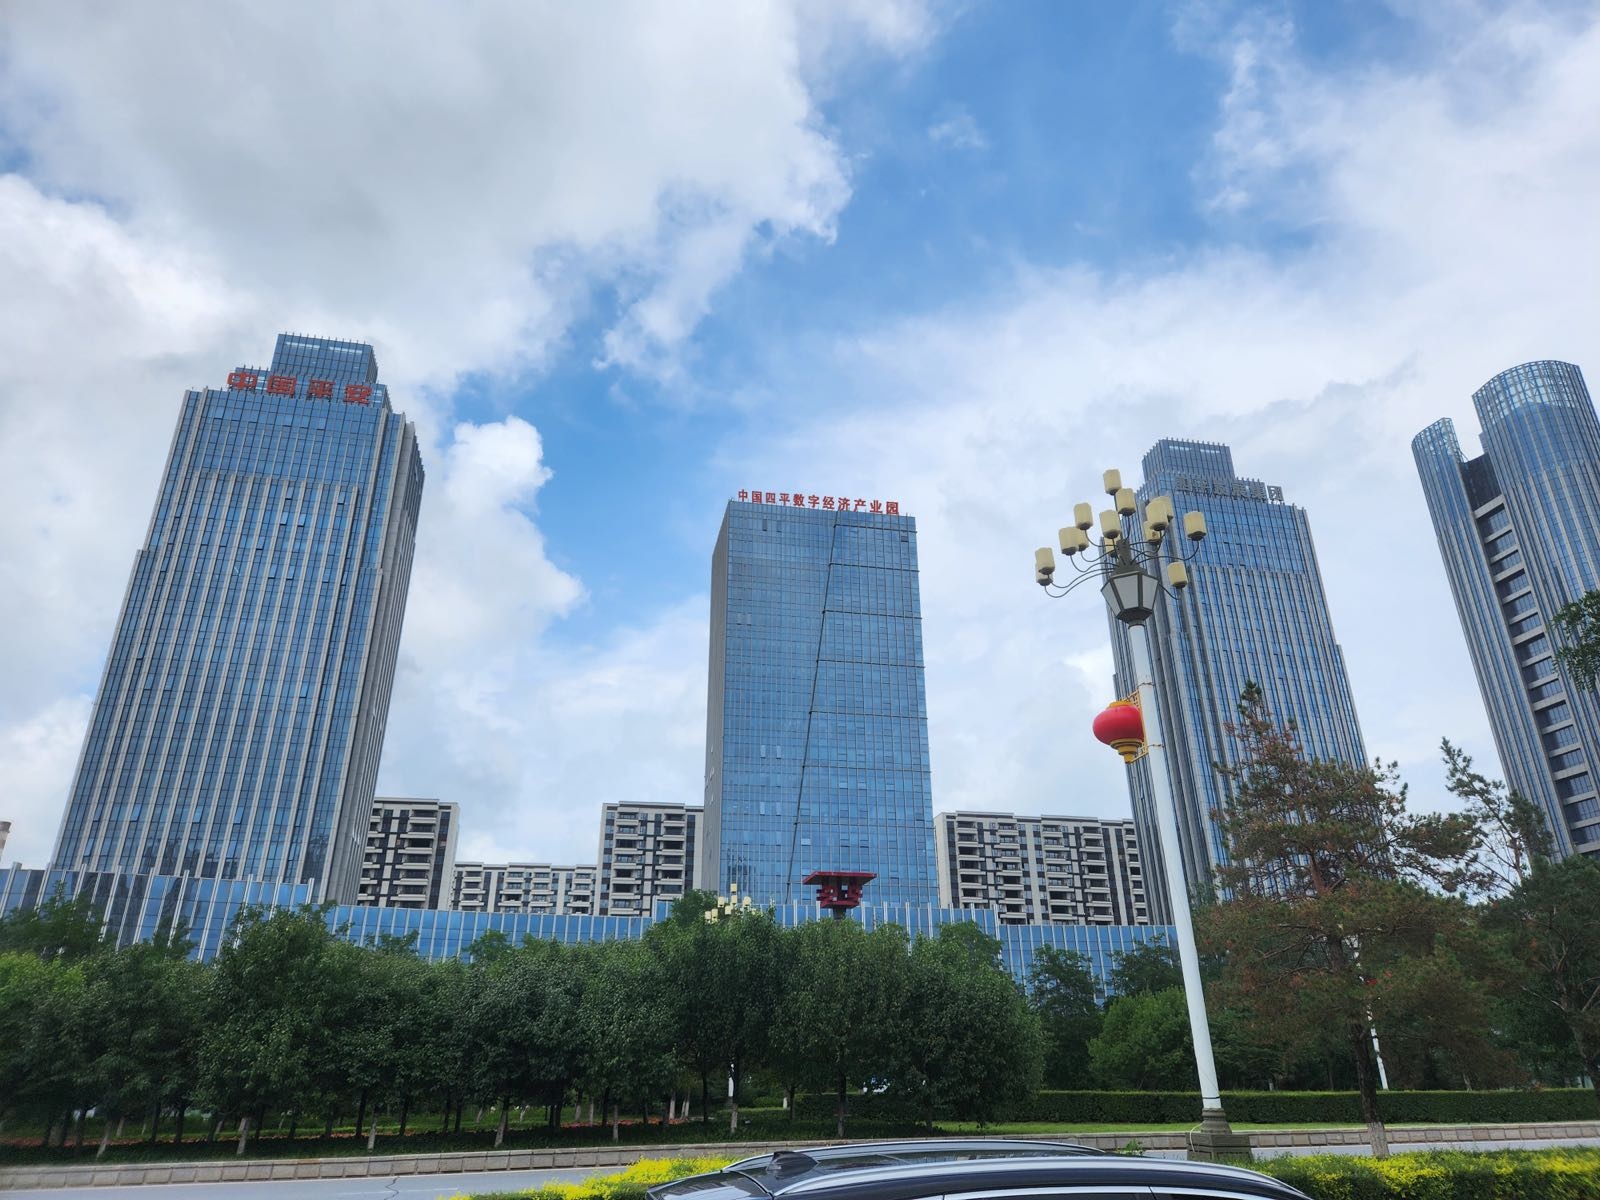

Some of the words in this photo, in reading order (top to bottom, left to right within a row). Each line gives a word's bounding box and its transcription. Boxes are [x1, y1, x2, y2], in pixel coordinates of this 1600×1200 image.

[738, 489, 899, 515] 中国四平数字经济产业园
